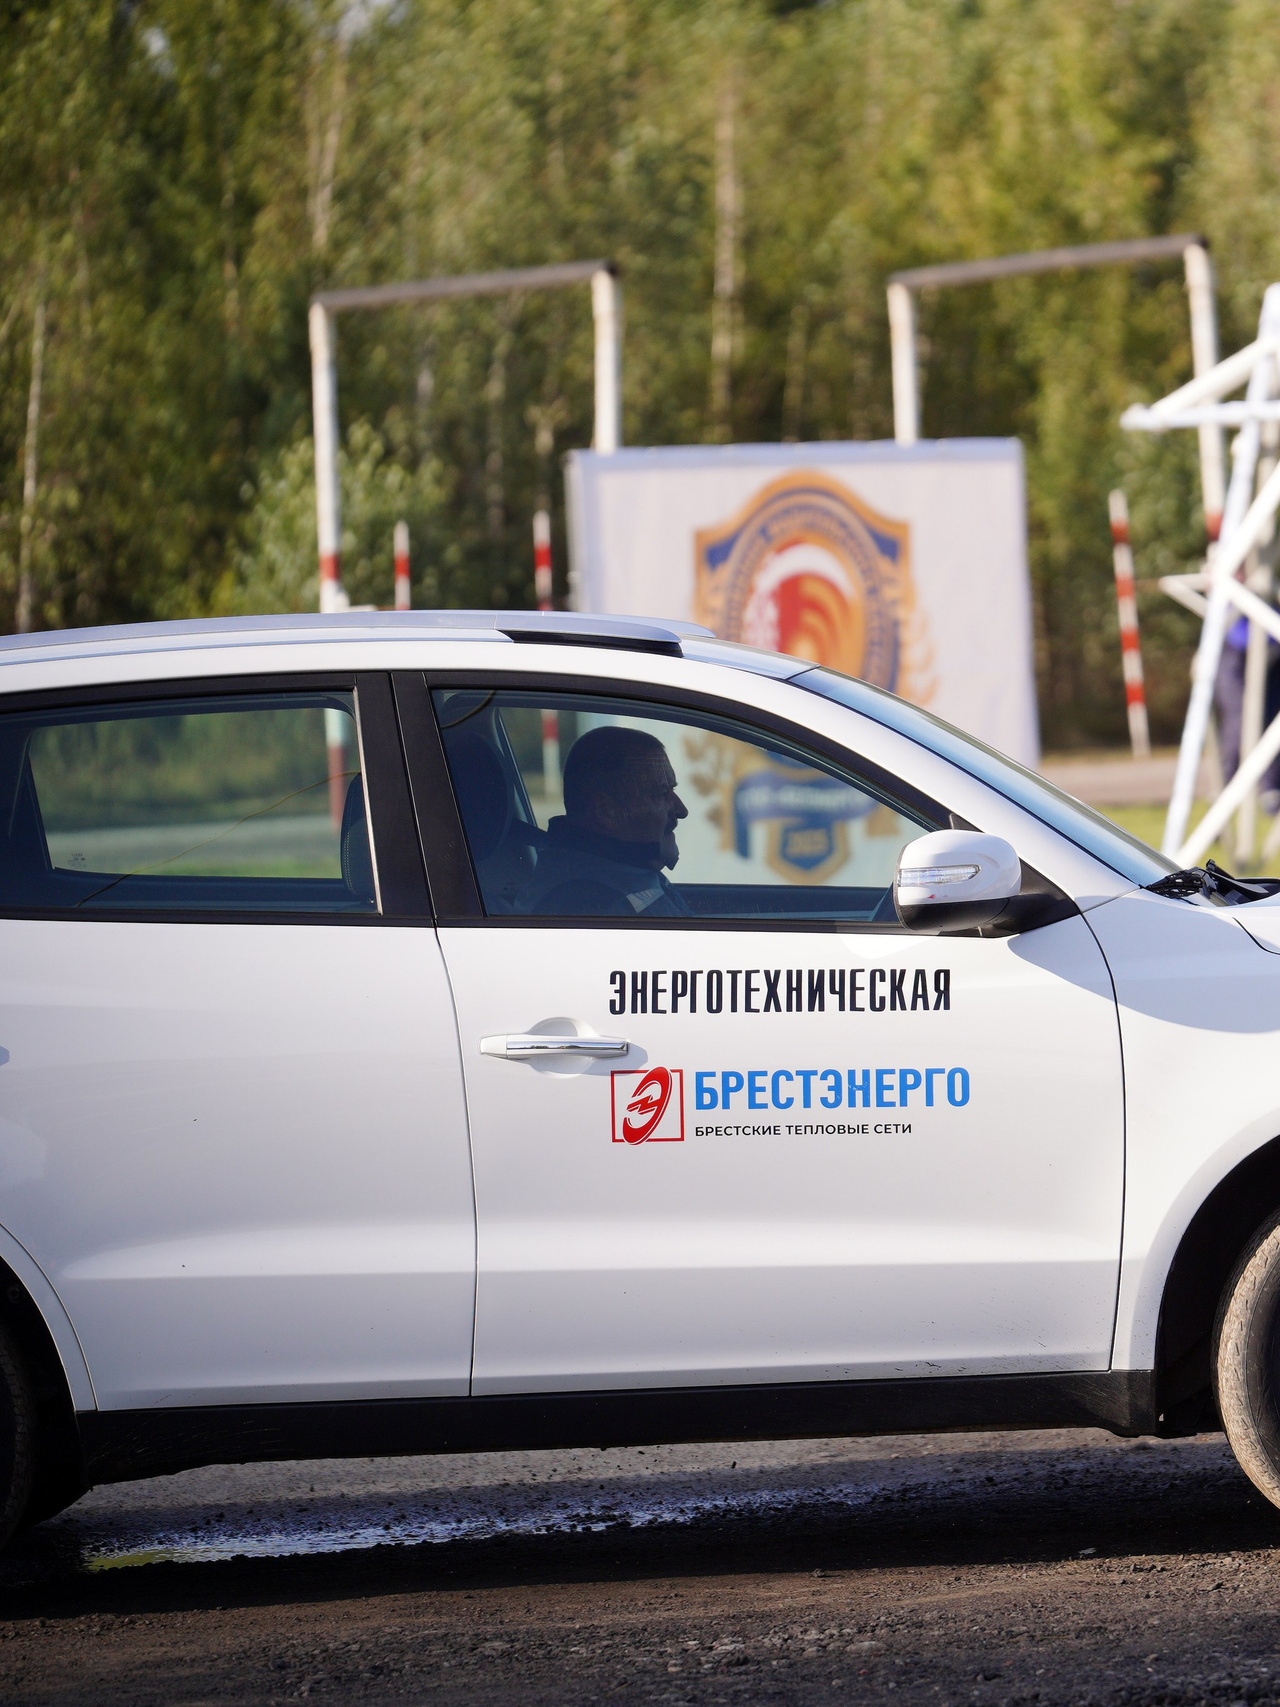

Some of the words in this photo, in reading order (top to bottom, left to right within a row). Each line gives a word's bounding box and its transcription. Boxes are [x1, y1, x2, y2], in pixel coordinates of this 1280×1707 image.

[609, 968, 951, 1015] ЭНЕРГОТЕХНИЧЕСКАЯ
[695, 1067, 970, 1110] БРЕСТЭНЕРГО
[695, 1125, 781, 1137] БРЕСТСКИЕ
[785, 1123, 869, 1136] ТЕПЛОВЫЕ
[873, 1122, 912, 1135] СЕТИ
